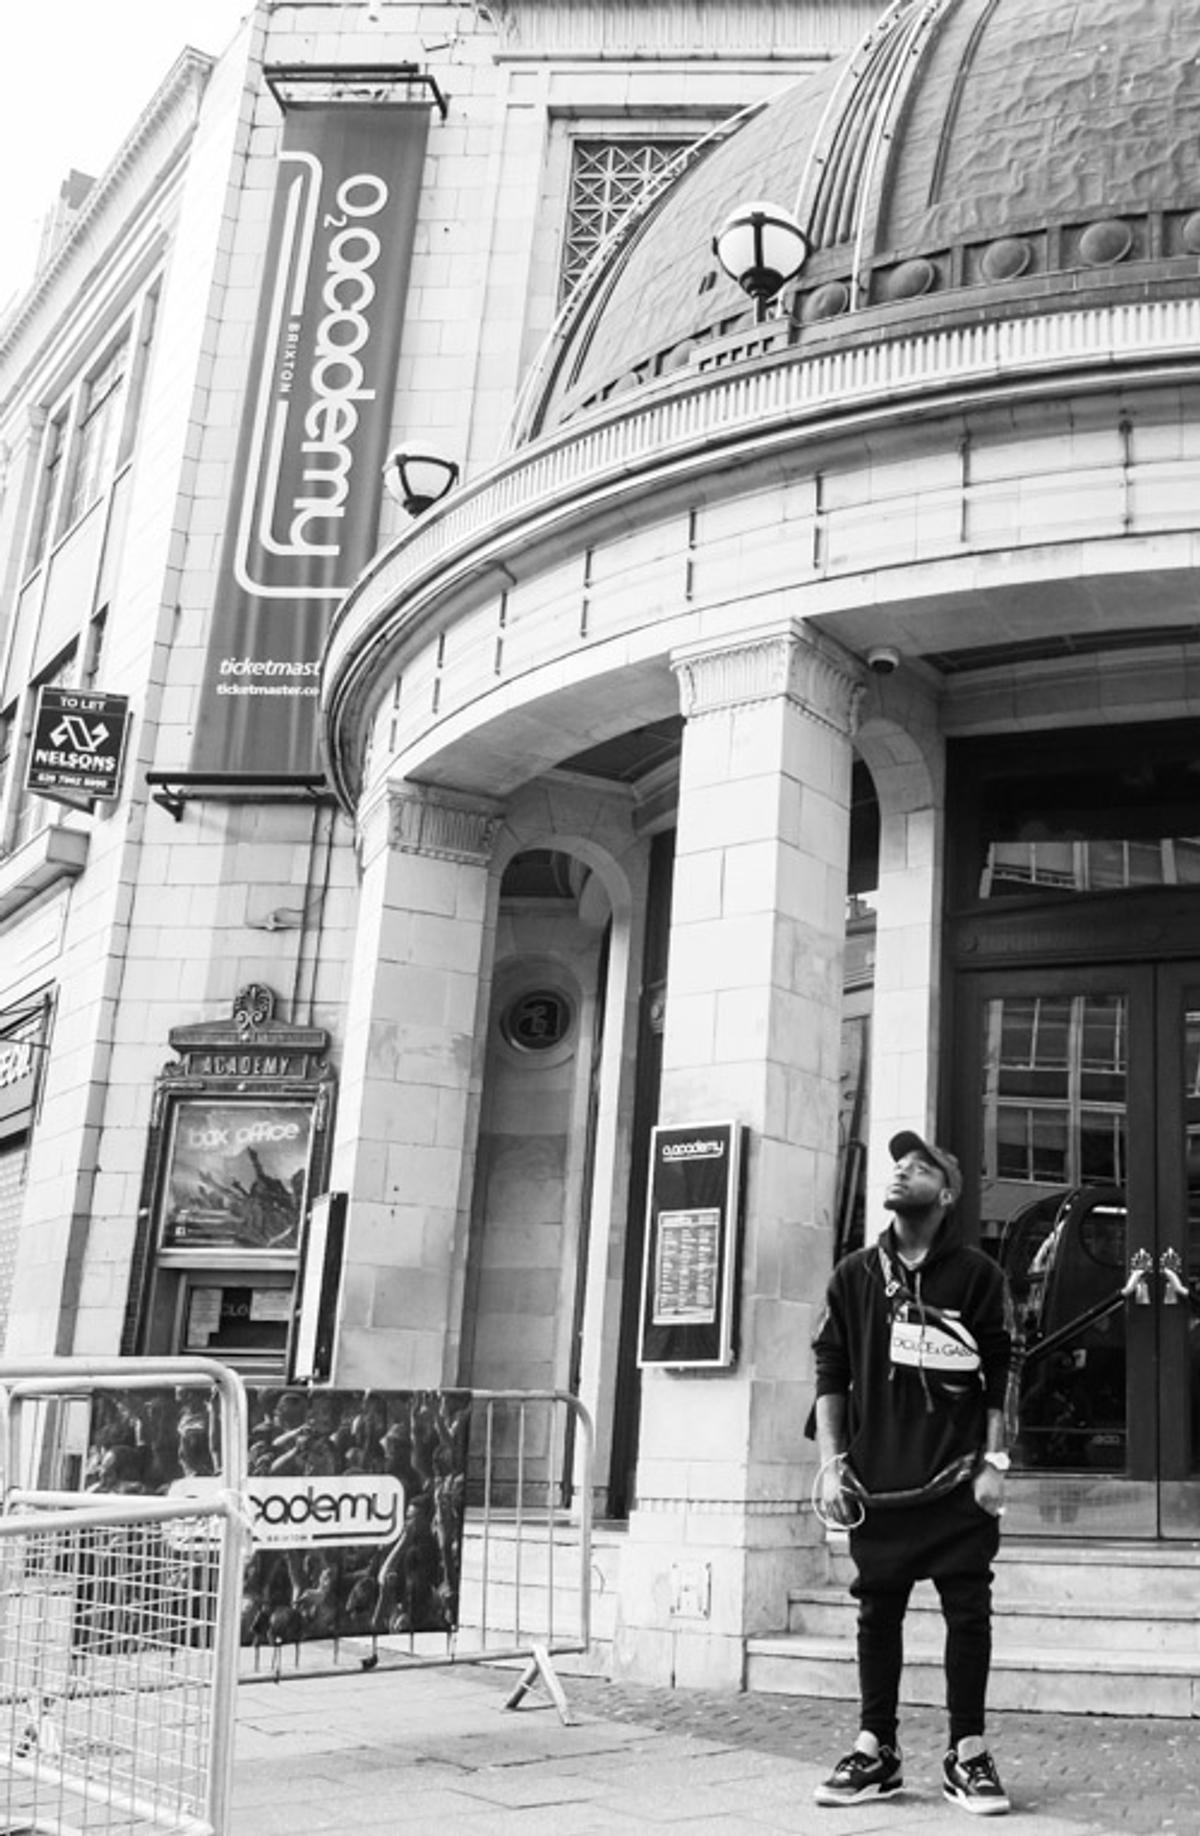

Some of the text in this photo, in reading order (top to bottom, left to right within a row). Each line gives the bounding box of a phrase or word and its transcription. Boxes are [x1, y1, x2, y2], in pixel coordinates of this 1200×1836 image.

[278, 322, 301, 394] BRIXTON
[60, 696, 106, 711] TO LET
[36, 748, 116, 772] NELSONS
[202, 1055, 292, 1076] ACADEMY
[188, 1121, 300, 1147] box office
